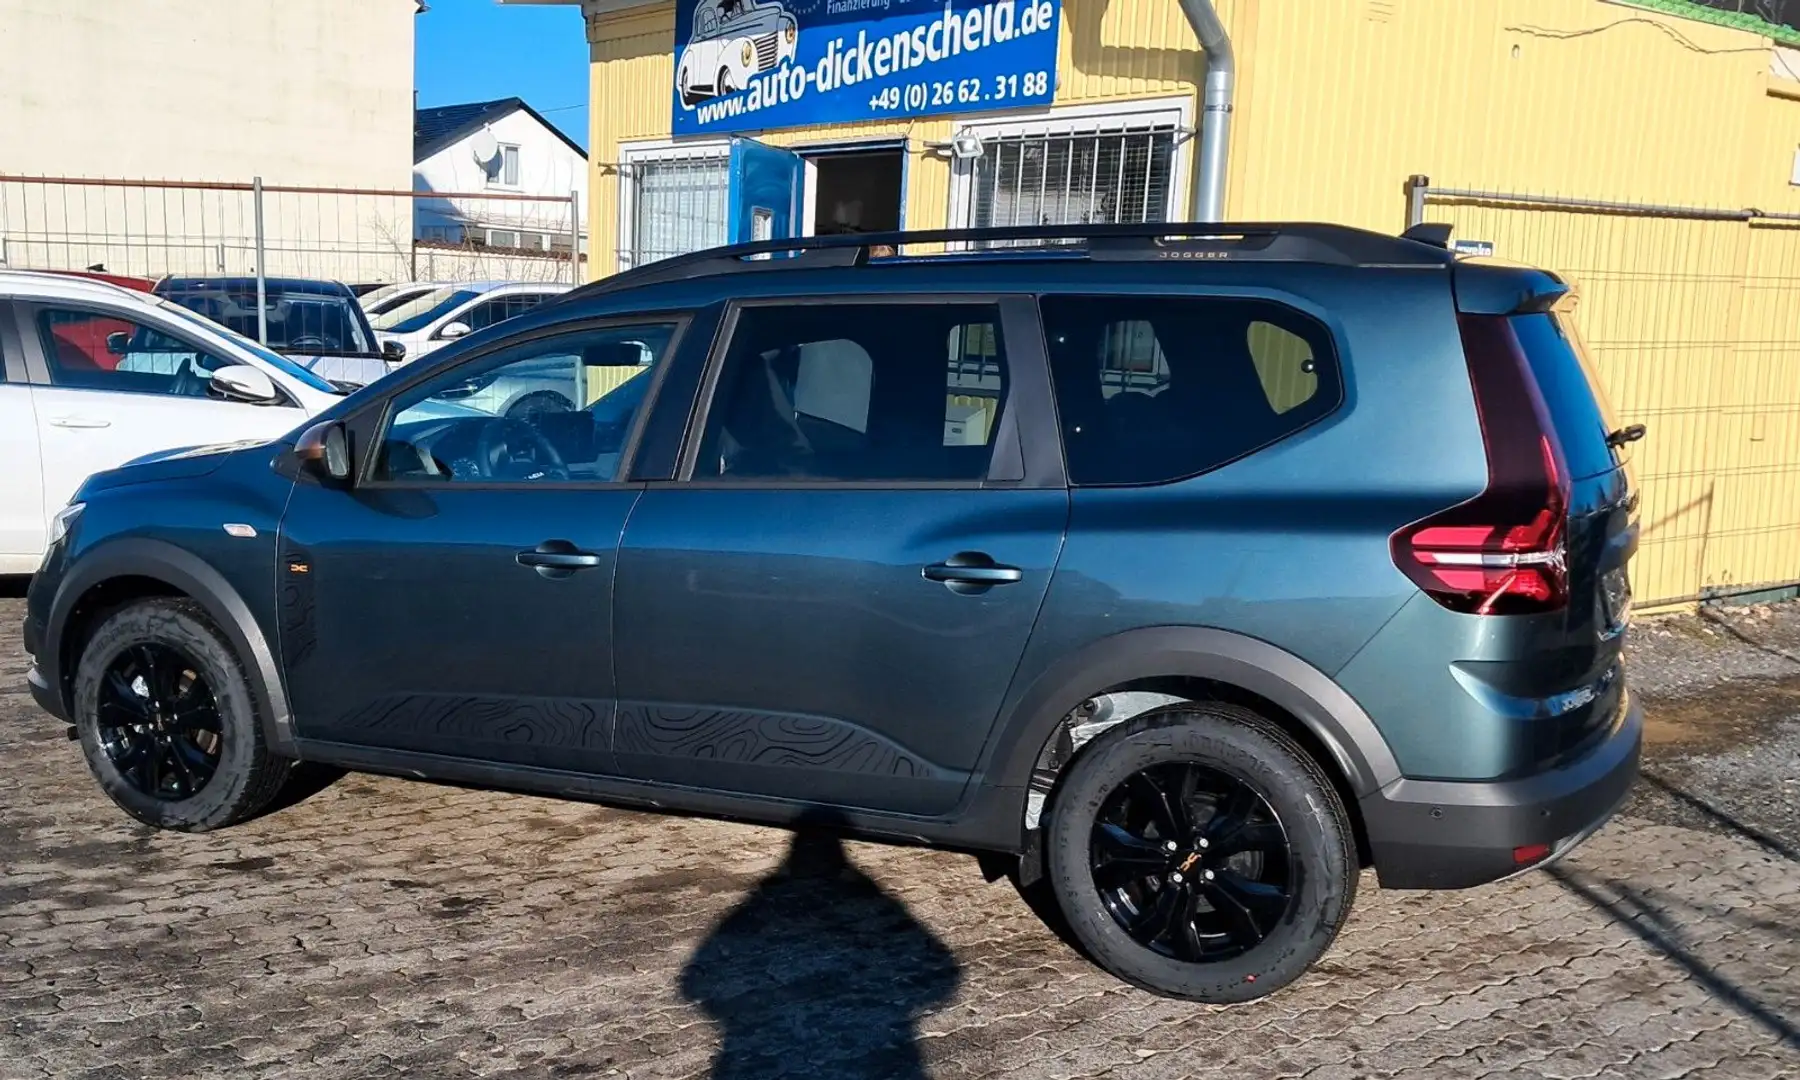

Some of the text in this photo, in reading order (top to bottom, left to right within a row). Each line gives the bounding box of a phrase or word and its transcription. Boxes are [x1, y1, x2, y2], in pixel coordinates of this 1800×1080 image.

[826, 0, 890, 14] Finanzierung
[697, 0, 1053, 125] www.auto-dickenscheid.de
[869, 86, 900, 112] +49
[904, 82, 928, 112] (0)
[931, 81, 954, 106] 26
[958, 78, 981, 103] 62
[994, 74, 1018, 100] 31
[1022, 71, 1048, 97] 88
[1159, 251, 1229, 259] JOGGER
